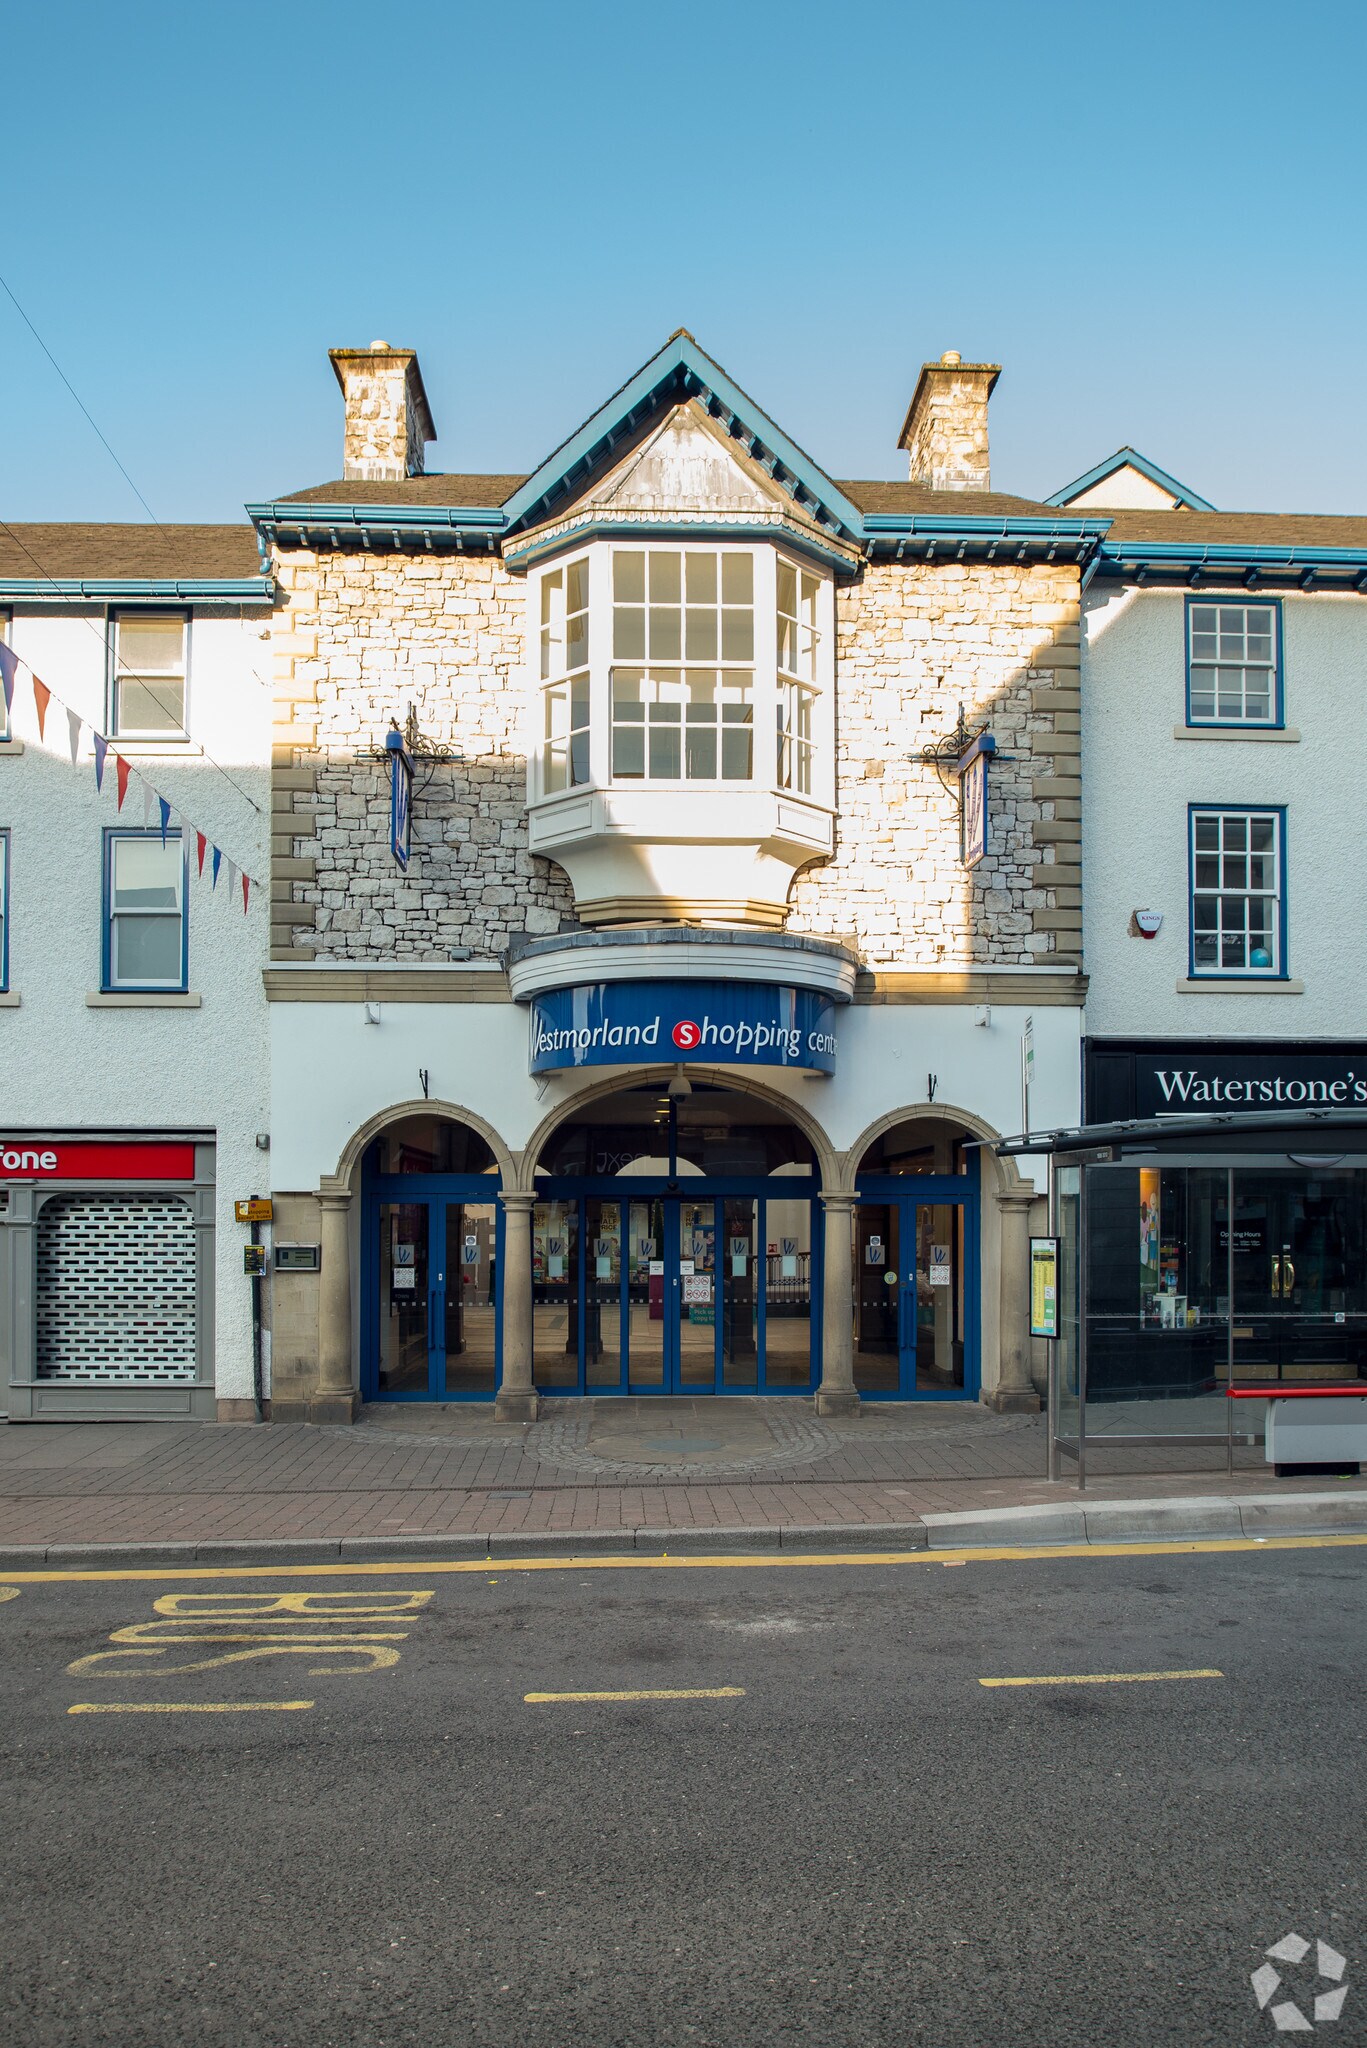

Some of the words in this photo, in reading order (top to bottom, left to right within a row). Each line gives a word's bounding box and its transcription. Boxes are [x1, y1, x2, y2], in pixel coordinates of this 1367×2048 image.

[678, 1016, 801, 1057] shopping
[808, 1032, 838, 1056] cent
[1154, 1071, 1367, 1101] Waterstone's
[63, 1590, 436, 1678] BUS
